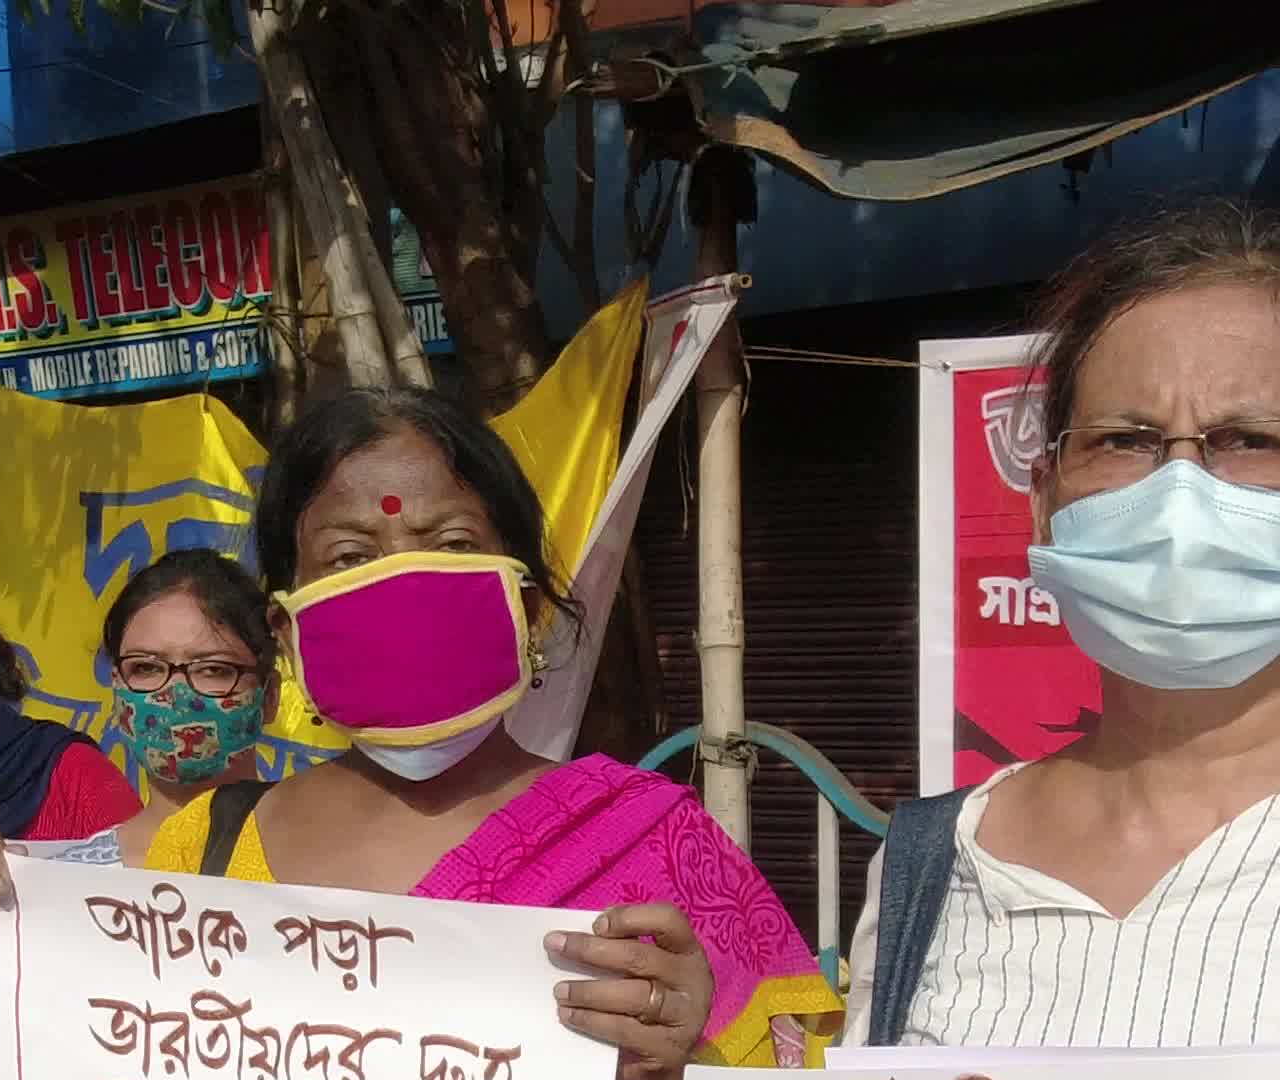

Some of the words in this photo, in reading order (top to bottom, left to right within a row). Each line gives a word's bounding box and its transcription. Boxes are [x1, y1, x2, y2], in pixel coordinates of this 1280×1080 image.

[28, 350, 94, 393] MOBILE
[95, 337, 193, 385] REPAIRING
[195, 340, 211, 372] &
[85, 884, 248, 981] আটকে
[274, 914, 414, 991] পড়া
